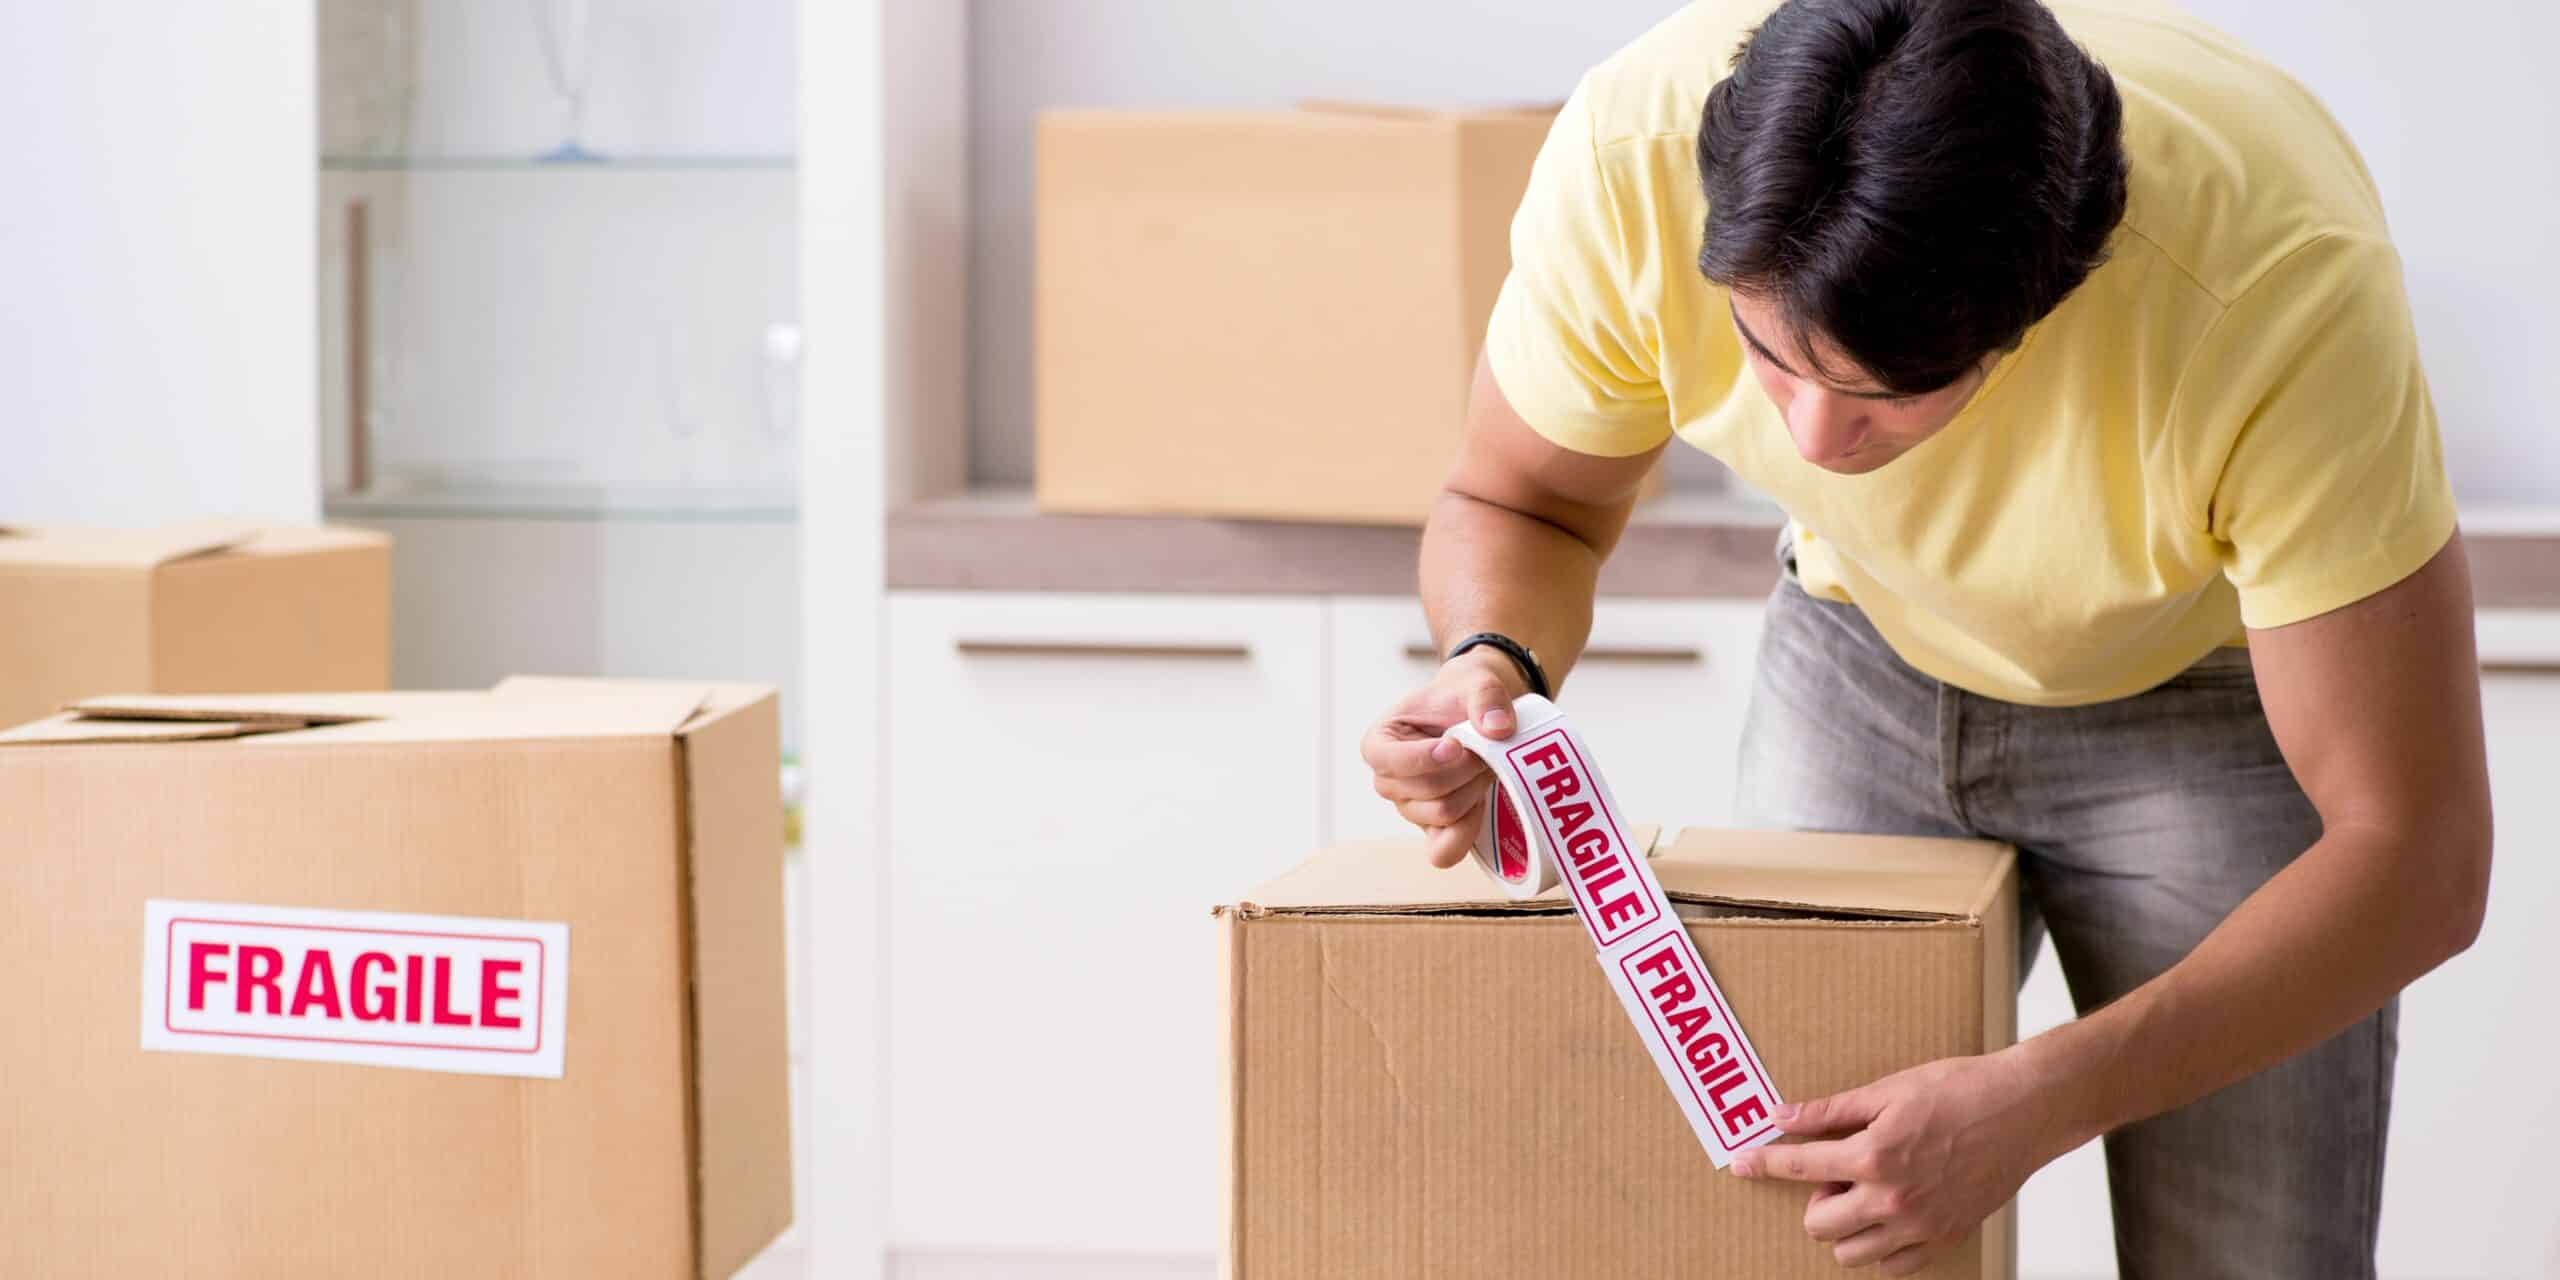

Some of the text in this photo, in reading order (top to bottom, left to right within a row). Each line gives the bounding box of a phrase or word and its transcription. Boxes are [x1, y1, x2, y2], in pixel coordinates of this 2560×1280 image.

[1523, 741, 1646, 932] FRAGILE
[187, 942, 523, 1029] FRAGILE
[1636, 946, 1768, 1137] FRAGILE
